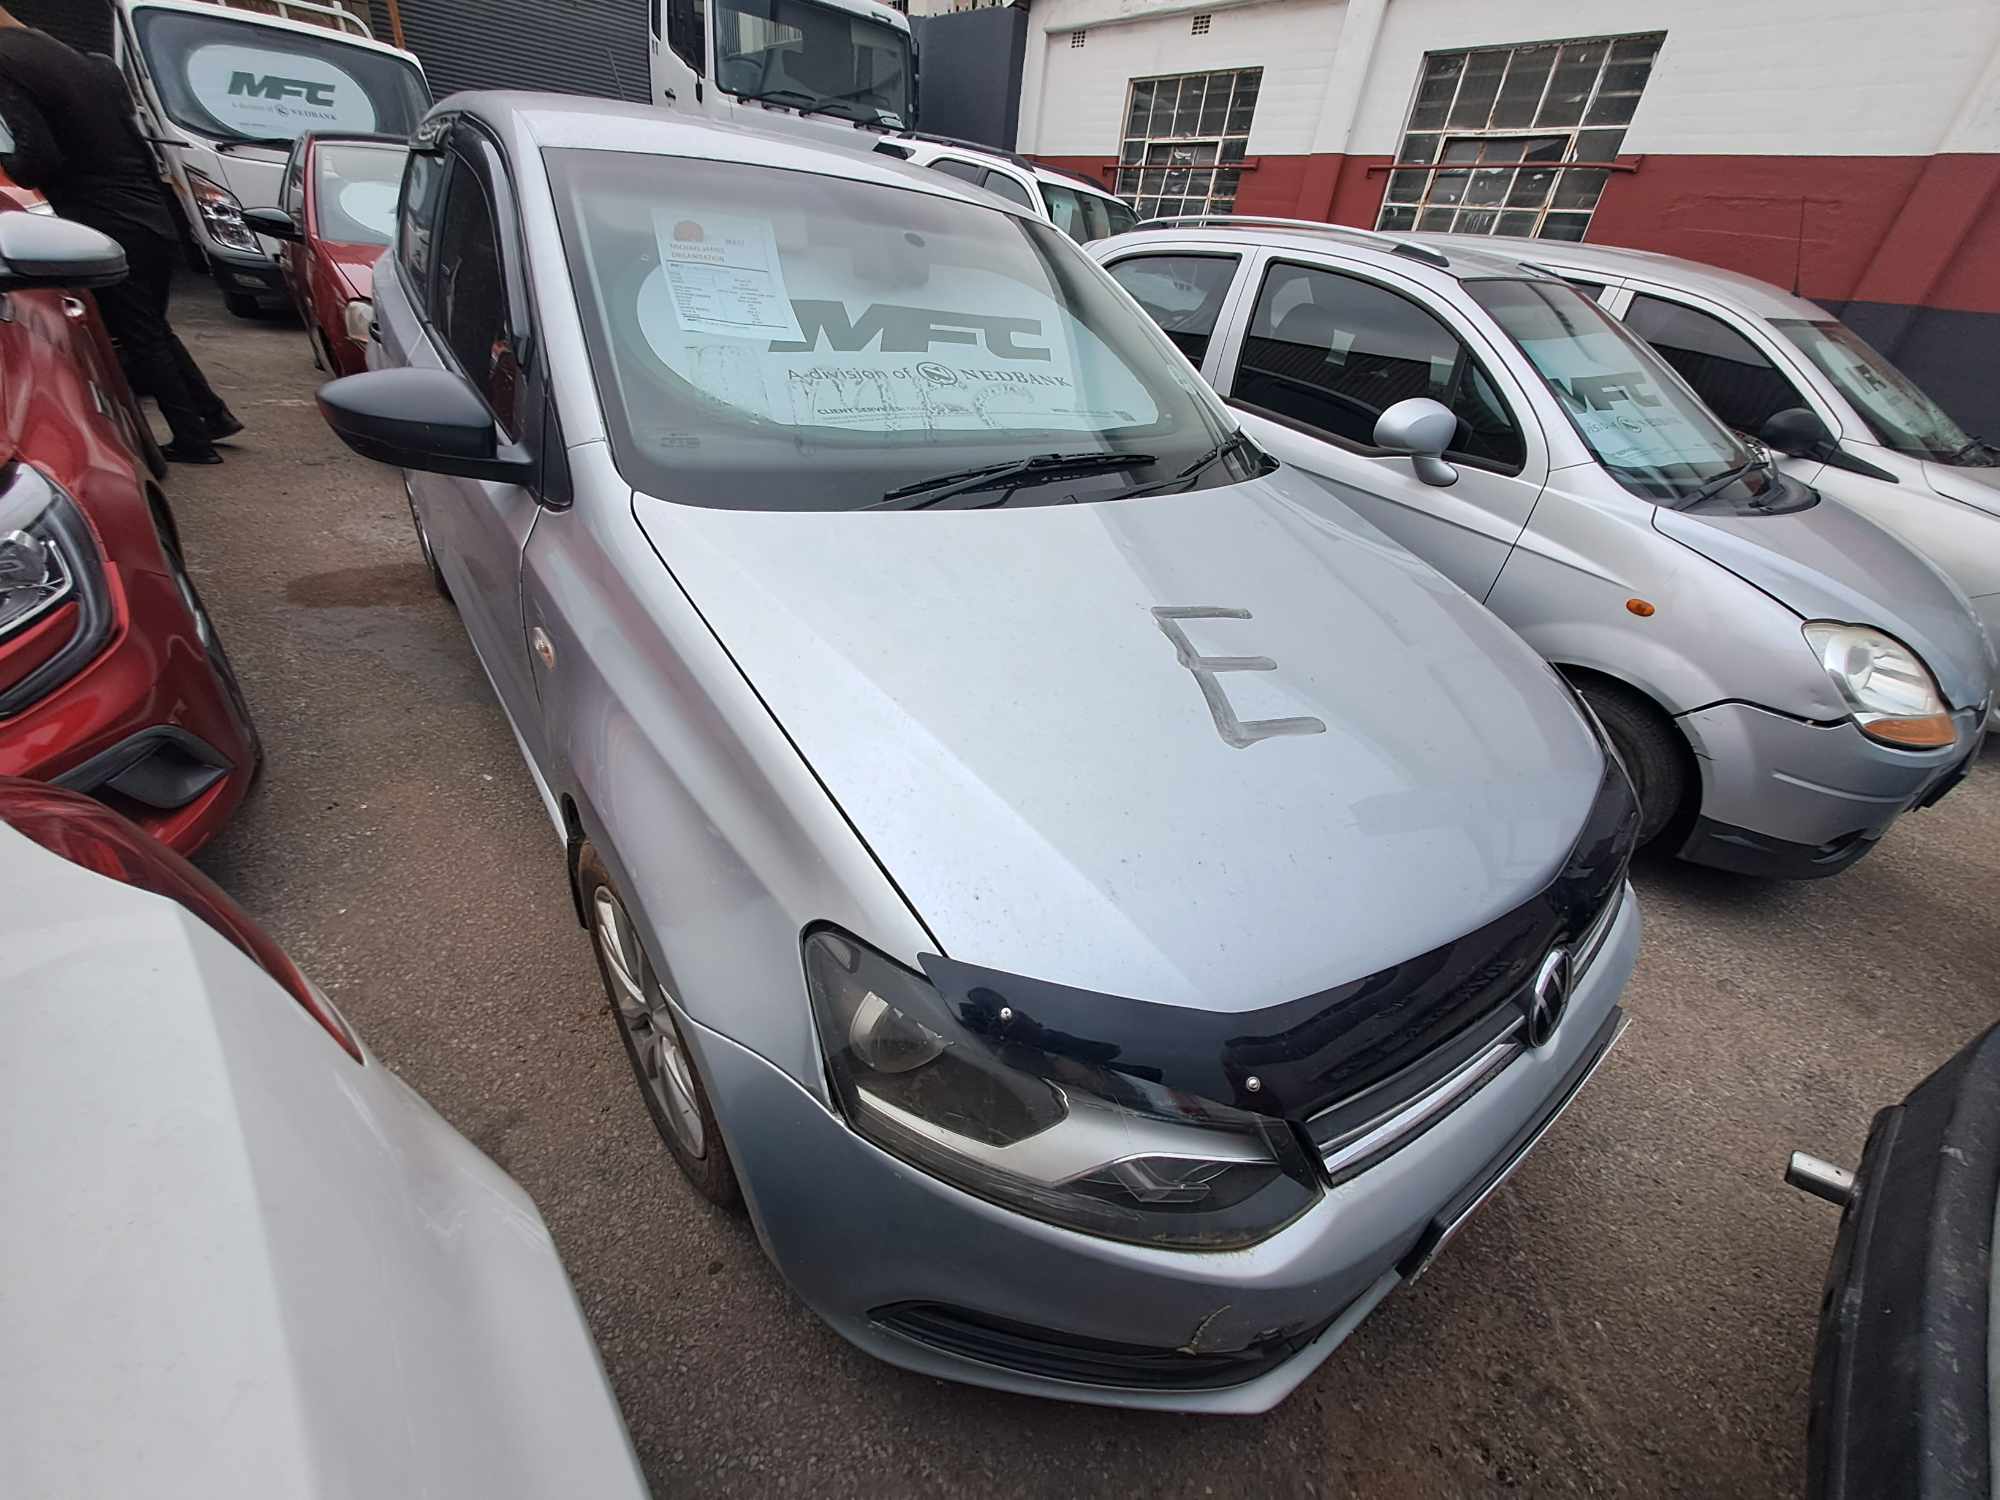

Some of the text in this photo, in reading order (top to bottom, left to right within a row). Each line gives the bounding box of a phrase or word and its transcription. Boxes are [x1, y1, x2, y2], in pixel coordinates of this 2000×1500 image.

[228, 71, 336, 107] MFC
[768, 299, 1051, 363] MFC
[788, 367, 1073, 388] A division of NEDBANK
